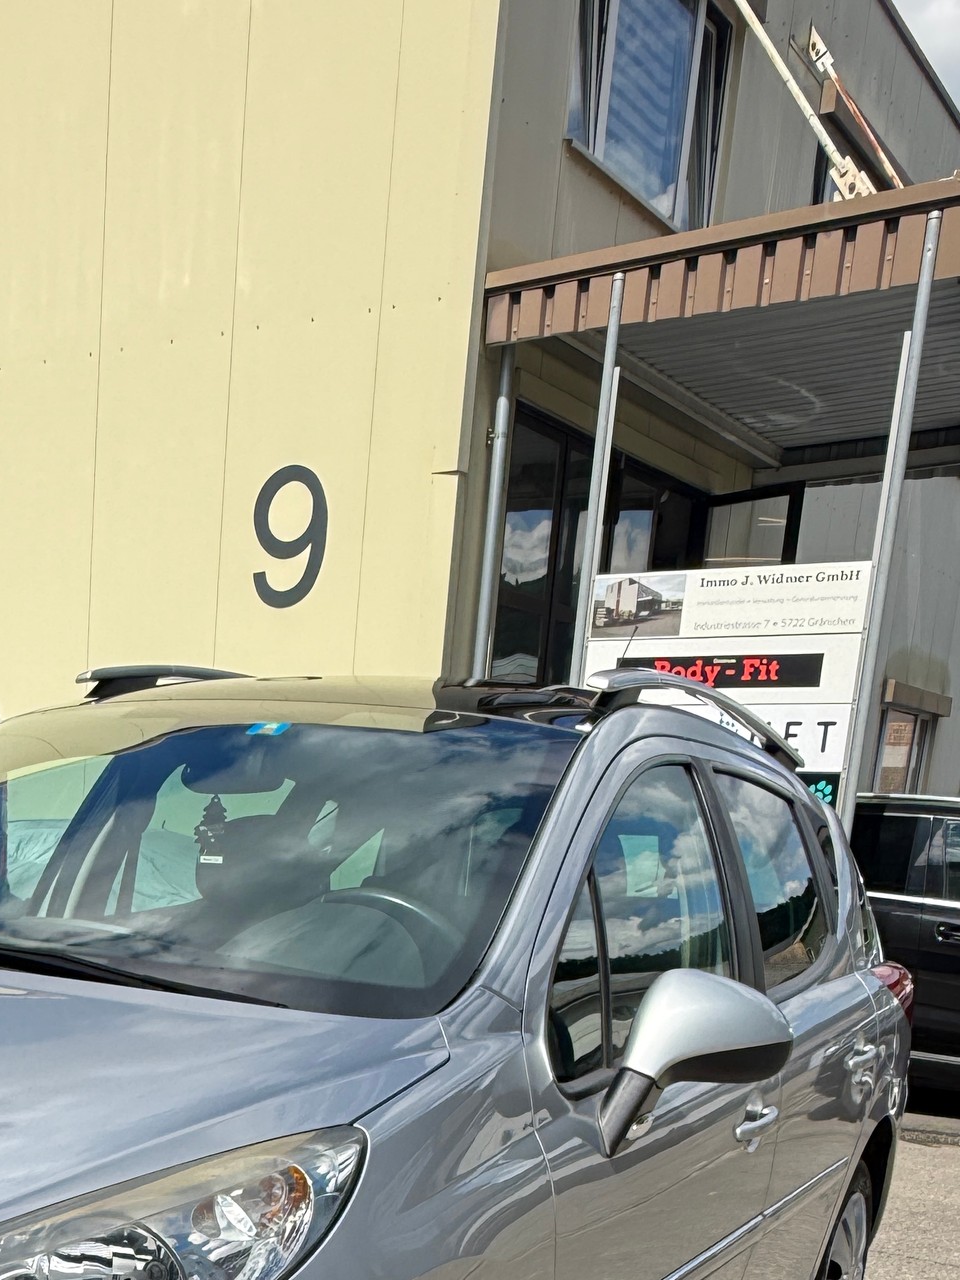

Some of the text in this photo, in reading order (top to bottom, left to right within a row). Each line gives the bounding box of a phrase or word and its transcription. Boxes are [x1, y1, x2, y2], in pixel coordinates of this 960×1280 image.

[253, 464, 328, 609] 9
[700, 570, 861, 588] Immo J. Widmer GmbH
[763, 619, 771, 629] 7
[781, 618, 805, 628] 5722
